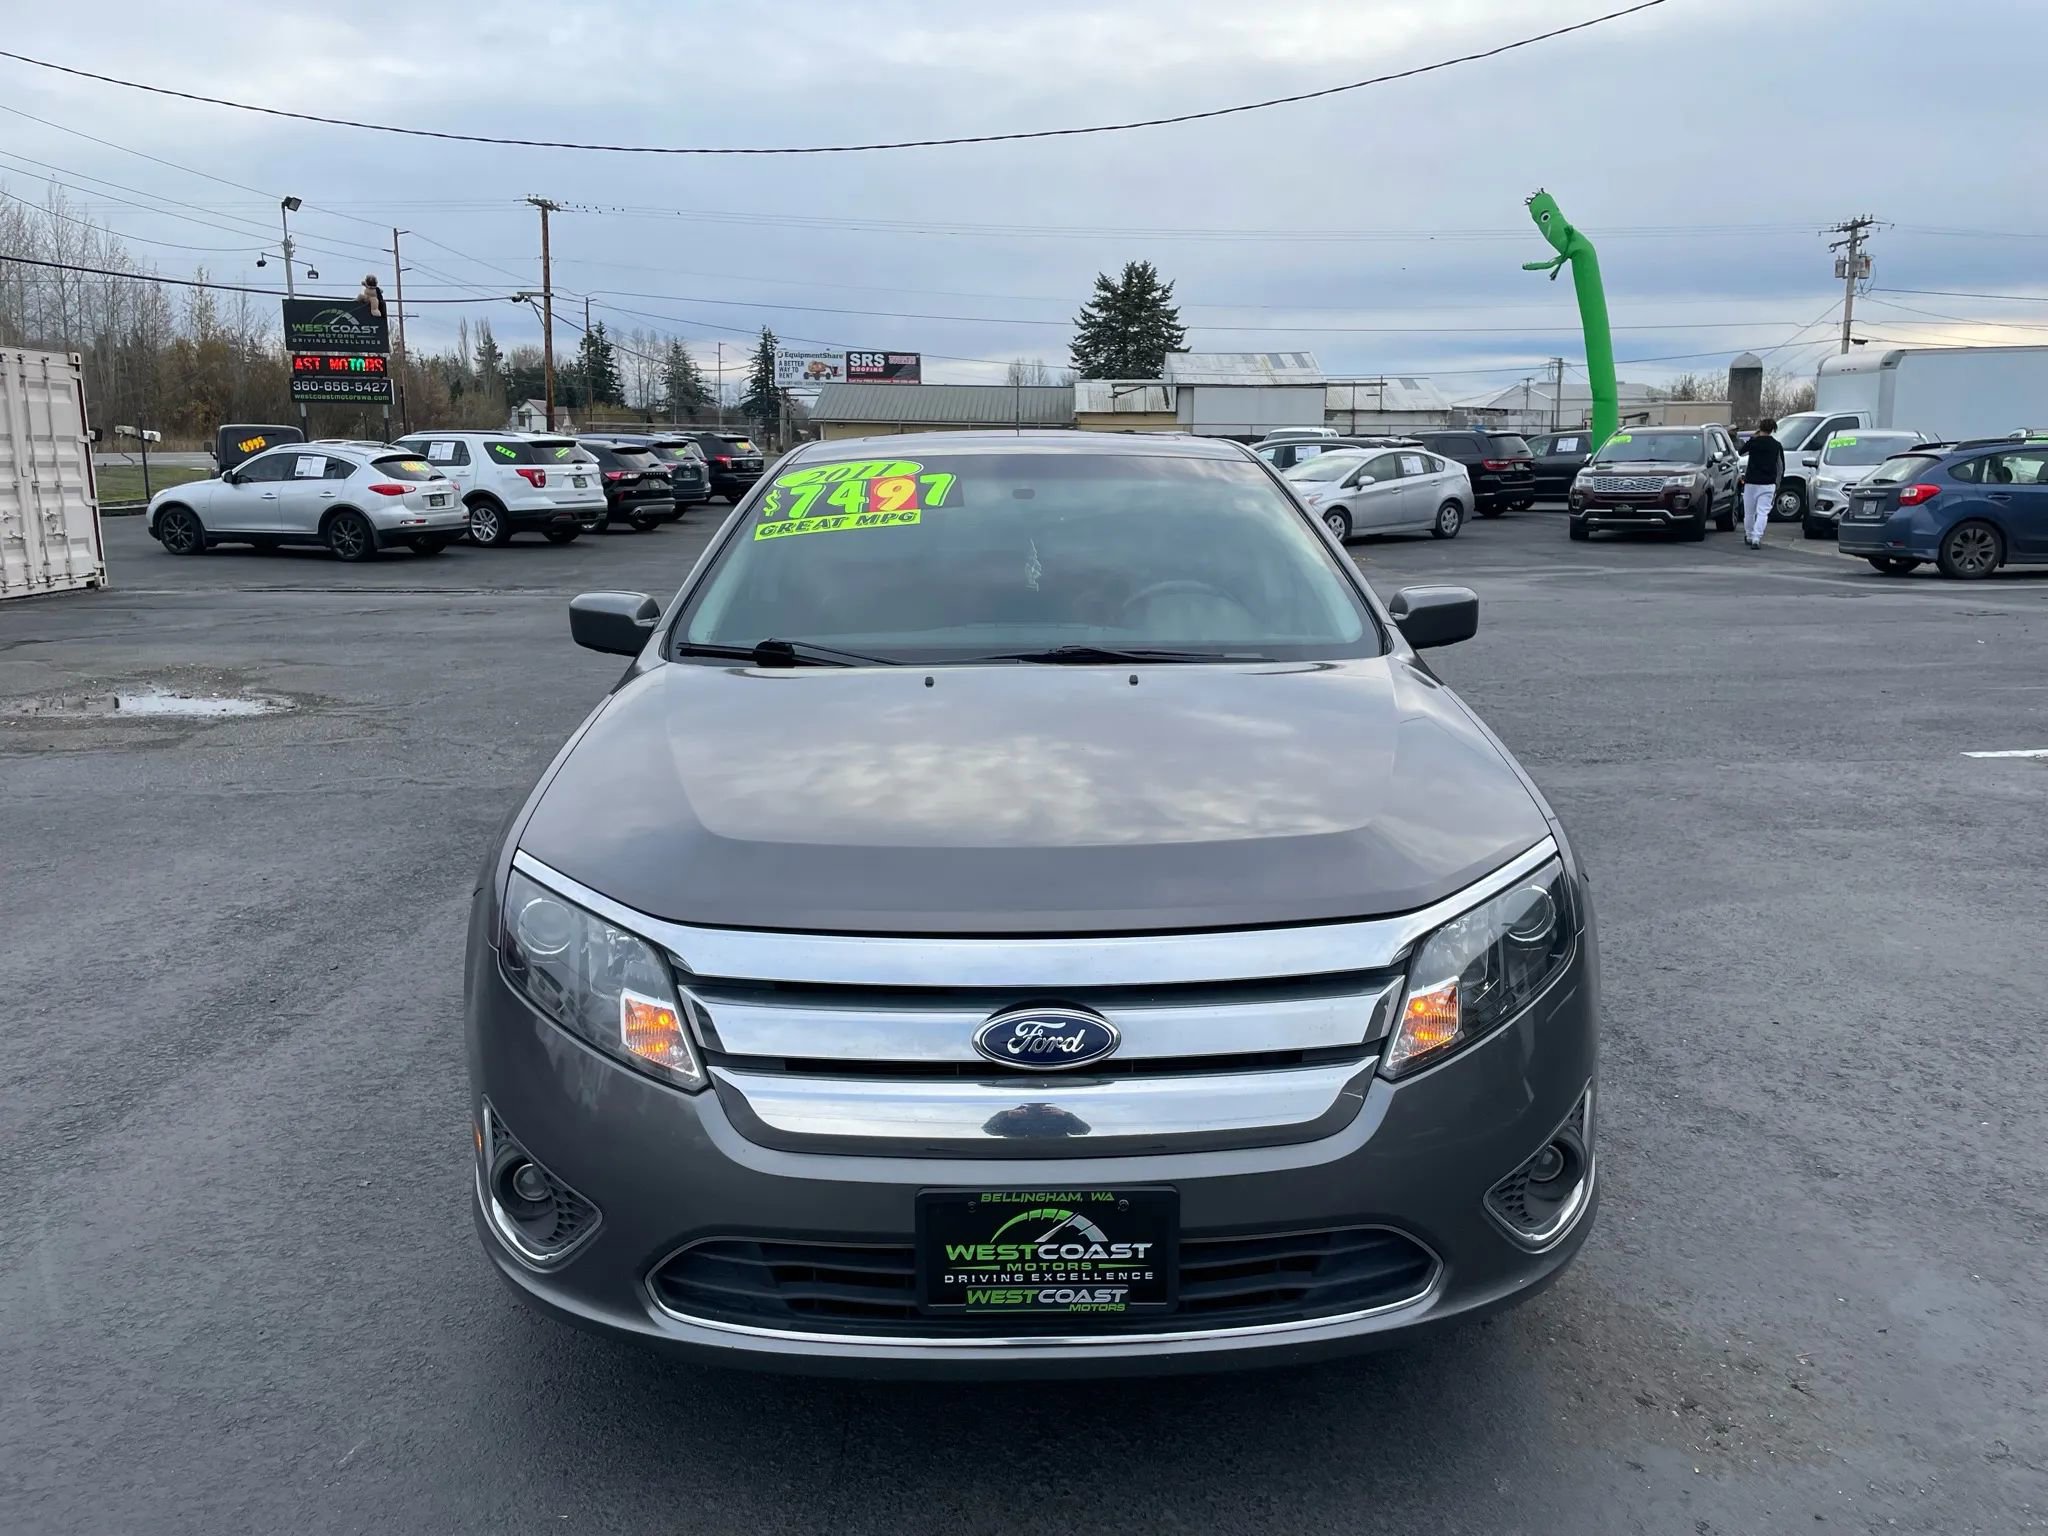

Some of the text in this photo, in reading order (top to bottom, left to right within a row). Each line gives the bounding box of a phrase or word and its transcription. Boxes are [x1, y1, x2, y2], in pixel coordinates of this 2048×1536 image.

[292, 324, 379, 334] WESTCOAST
[295, 357, 321, 370] AST
[849, 353, 885, 367] SRS
[293, 380, 388, 392] 360-656-5427
[294, 393, 389, 401] westcoastmotorswa.com
[803, 462, 897, 484] 2011
[759, 511, 917, 537] GREAT MPG
[1007, 1020, 1086, 1054] Ford
[981, 1192, 1115, 1203] BELLINGHAM, WA
[945, 1243, 1153, 1261] WESTCOAST
[1007, 1262, 1093, 1271] MOTORS
[945, 1272, 1154, 1284] DRIVING EXCELLENCE
[966, 1289, 1129, 1305] WESTCOAST
[1069, 1304, 1126, 1312] MOTORS
